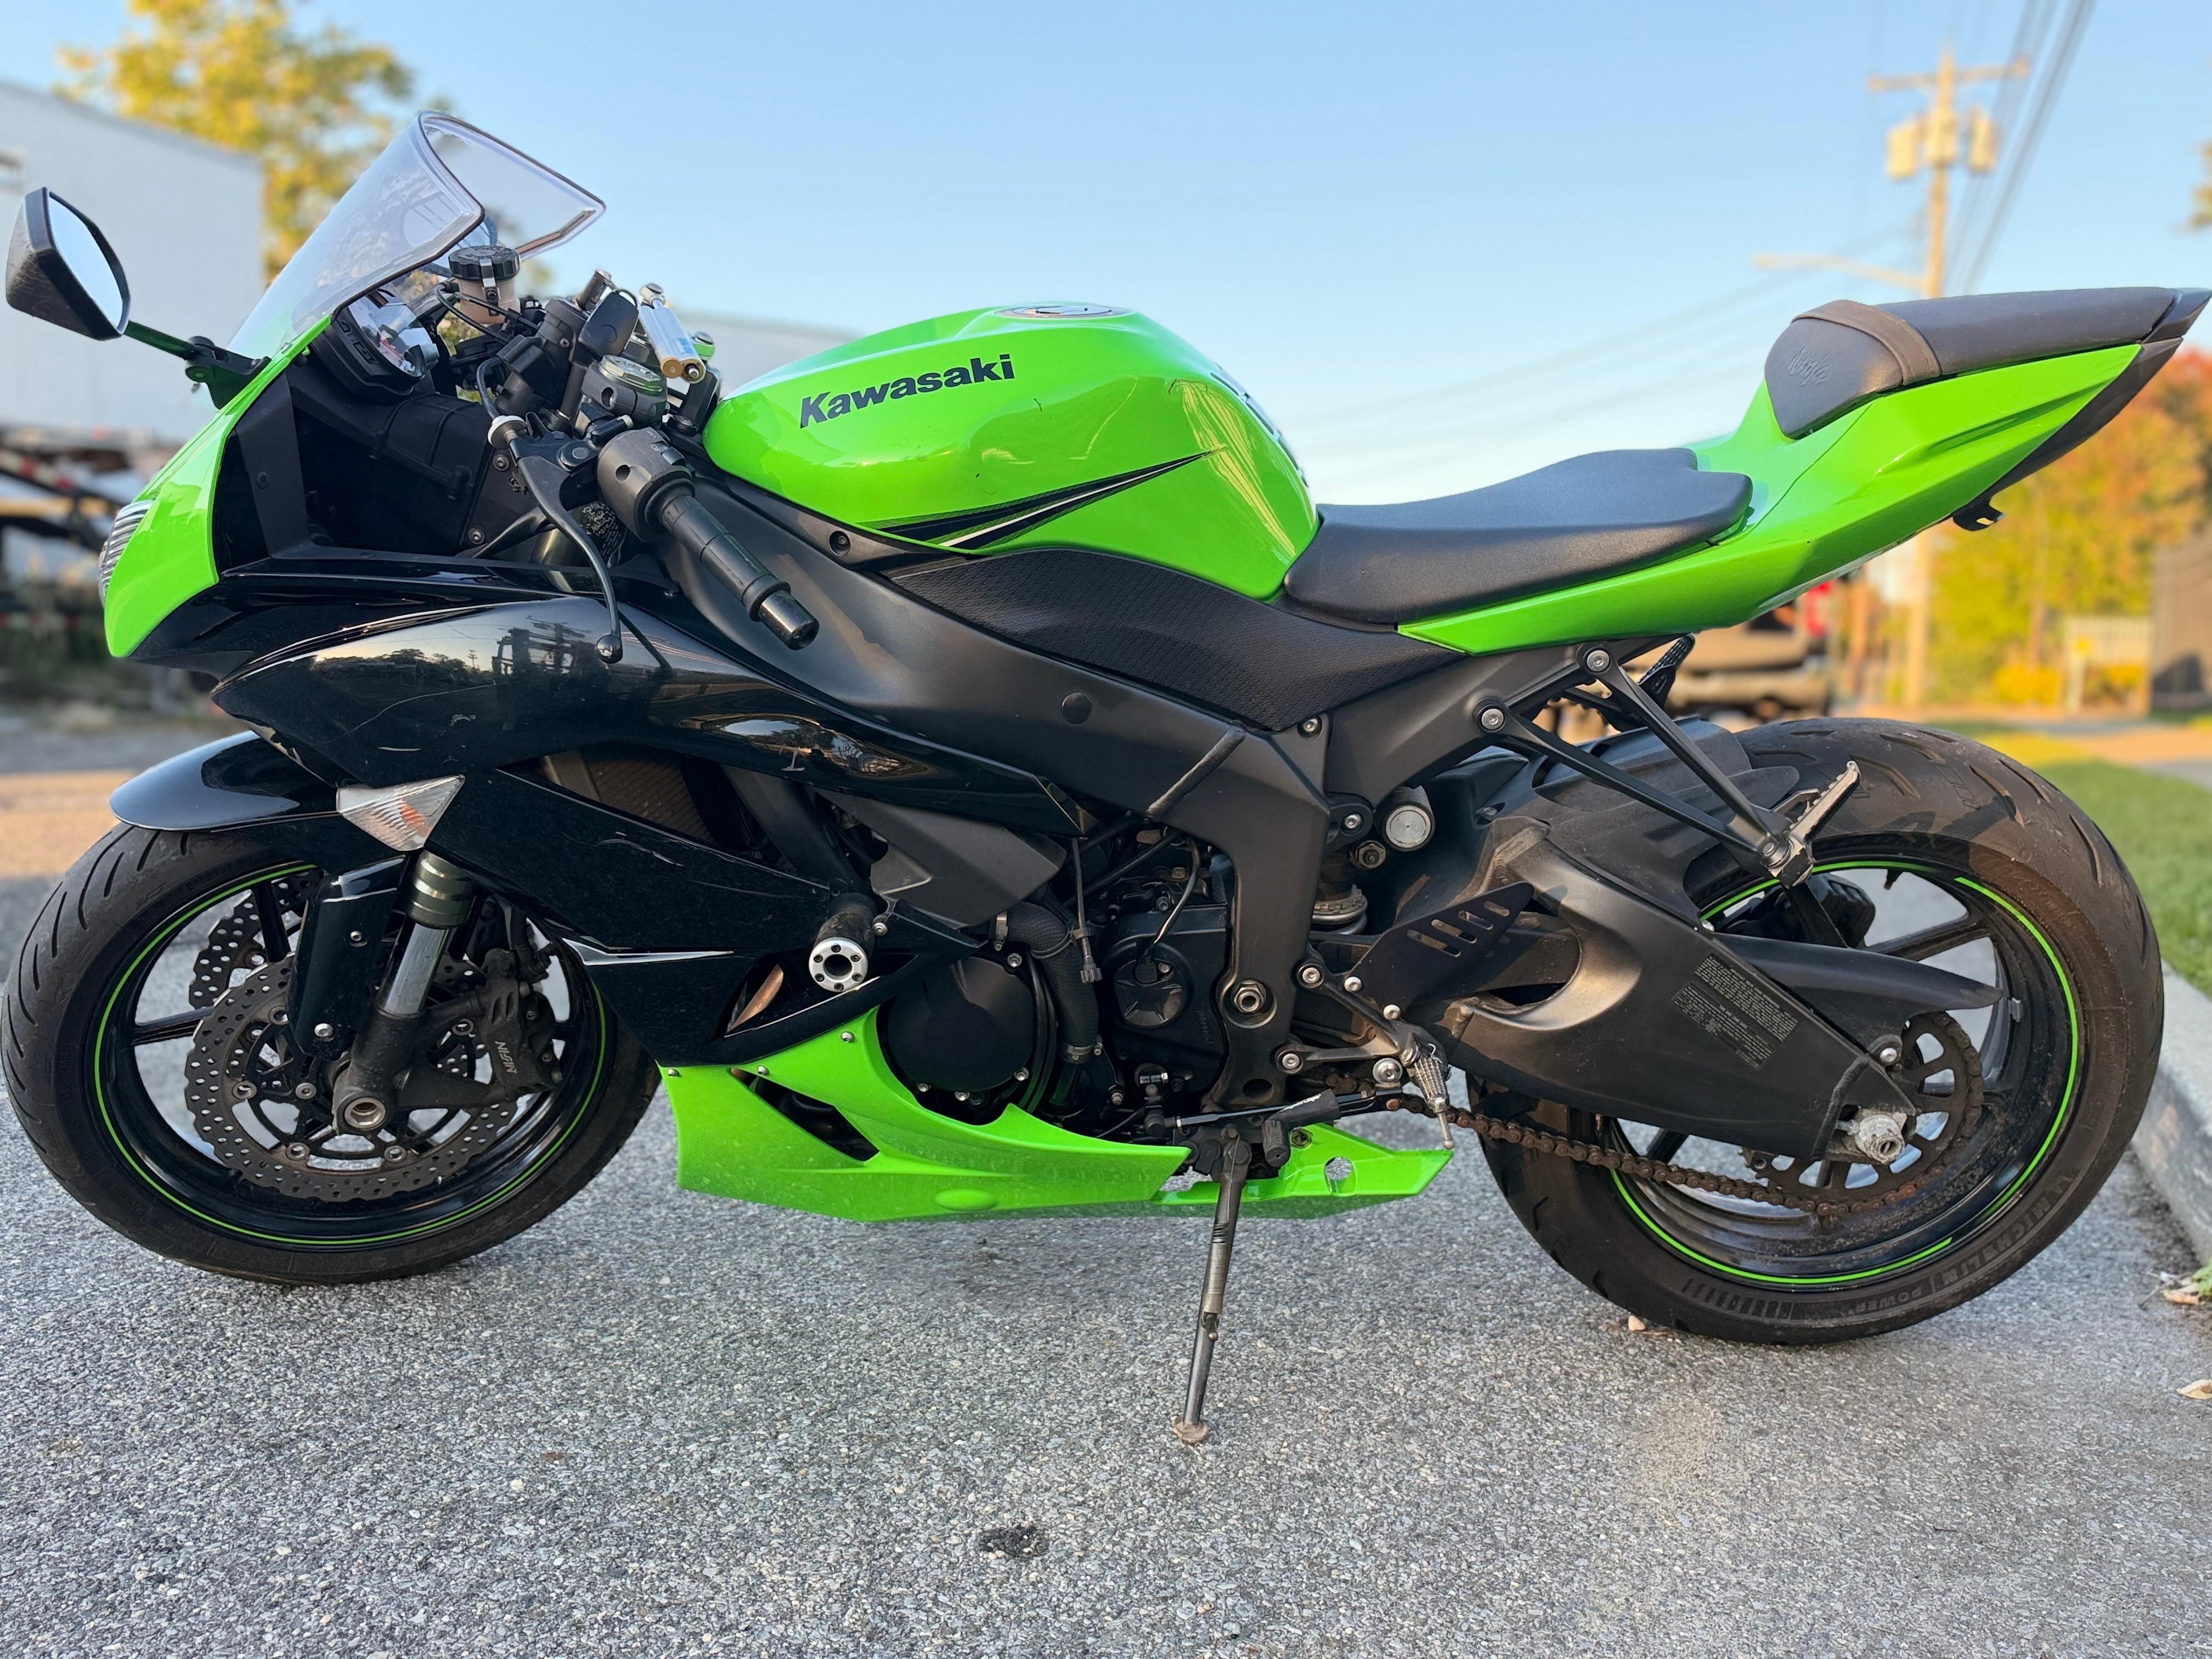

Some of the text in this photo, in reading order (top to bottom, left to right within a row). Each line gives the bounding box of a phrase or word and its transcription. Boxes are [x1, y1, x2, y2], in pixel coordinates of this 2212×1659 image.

[800, 353, 1015, 428] Kawasaki
[1787, 346, 1830, 389] Ninja
[494, 1041, 518, 1074] NISSIN
[1855, 1196, 2051, 1312] MICHELIN POWER
